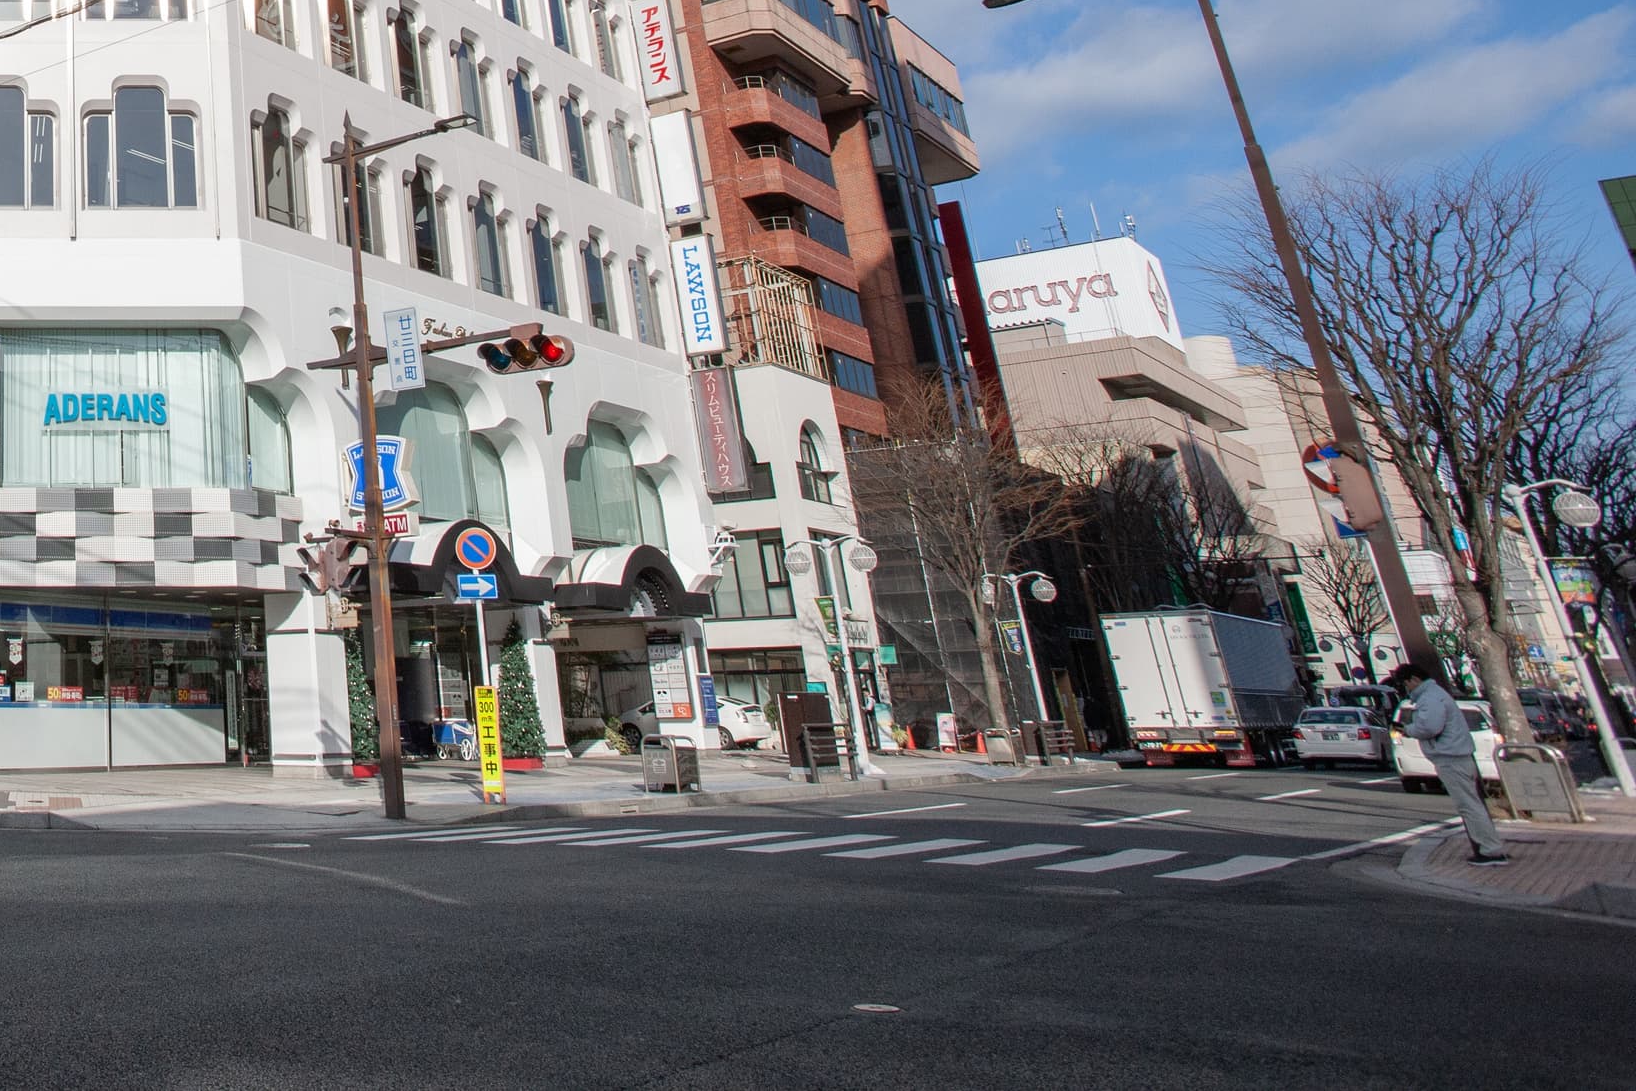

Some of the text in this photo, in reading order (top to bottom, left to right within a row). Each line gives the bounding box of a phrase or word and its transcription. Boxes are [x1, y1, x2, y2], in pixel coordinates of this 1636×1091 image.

[682, 245, 712, 343] LAWSON
[987, 273, 1117, 315] aruya
[398, 314, 418, 381] 廿三日町
[44, 393, 168, 426] ADERANS
[705, 372, 732, 486] スリムビューティハウス
[352, 444, 397, 460] LSON
[384, 516, 407, 534] ATM
[478, 701, 494, 713] 300
[482, 726, 498, 775] 工事中
